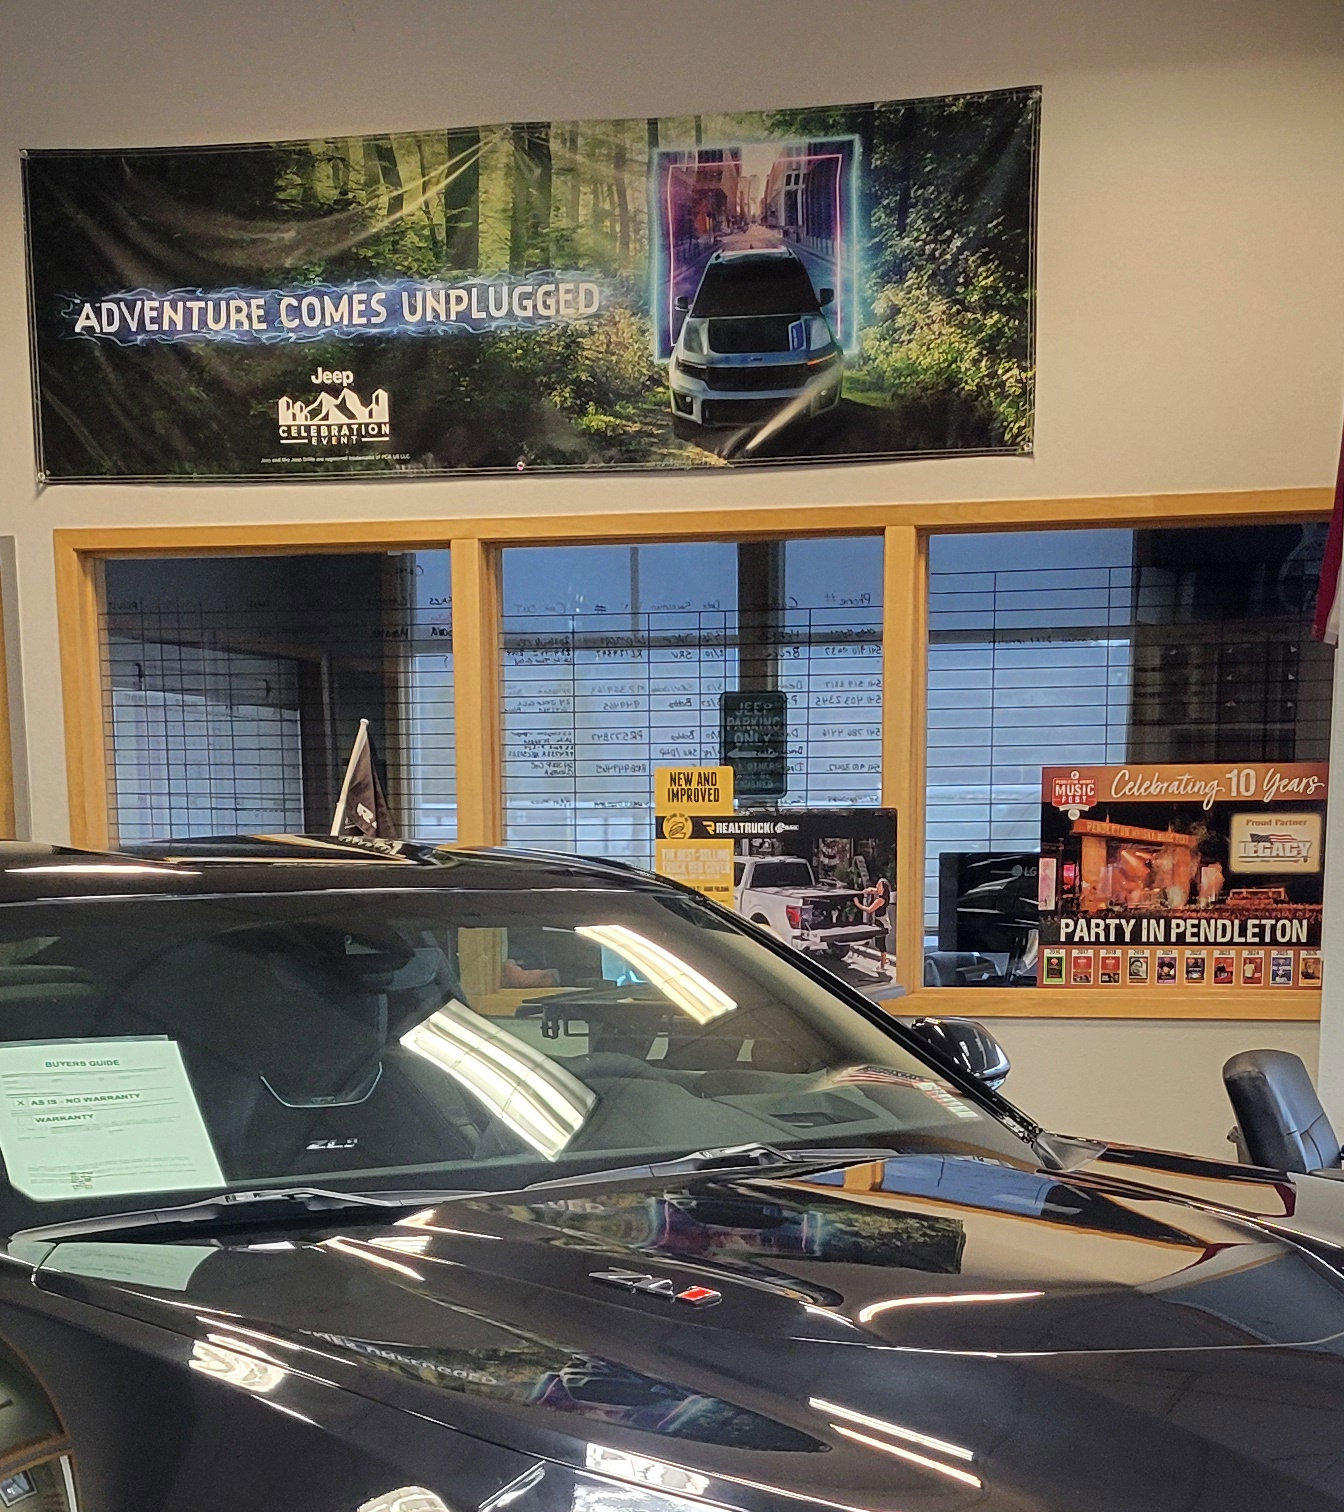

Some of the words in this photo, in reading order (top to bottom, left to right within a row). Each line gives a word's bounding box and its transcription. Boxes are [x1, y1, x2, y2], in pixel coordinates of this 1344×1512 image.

[74, 298, 268, 334] ADVENTURE
[279, 292, 388, 329] COMES
[401, 281, 601, 323] UNPLUGGED
[310, 366, 354, 387] Jeep
[278, 423, 390, 437] CELEBRATION
[311, 435, 358, 446] EVENT
[726, 716, 781, 732] PARKING
[669, 771, 694, 787] NEW
[696, 771, 717, 787] AND
[667, 787, 720, 803] IMPROVED
[1055, 783, 1095, 797] MUSIC
[1110, 769, 1226, 811] Celebrating
[1226, 768, 1256, 797] 10
[1262, 767, 1326, 803] Years
[1061, 795, 1087, 804] FEST
[716, 822, 775, 834] REALTRUCK
[1245, 818, 1272, 827] Proud
[1275, 818, 1308, 826] Partner
[1238, 840, 1312, 857] LEGACY
[1024, 866, 1037, 877] LG
[1059, 917, 1137, 943] PARTY
[1141, 918, 1165, 943] IN
[1170, 917, 1308, 943] PENDLETON
[45, 1060, 87, 1068] BUYERS
[89, 1059, 121, 1067] GUIDE
[83, 1093, 141, 1103] WARRANTY
[35, 1113, 94, 1123] WARRANTY
